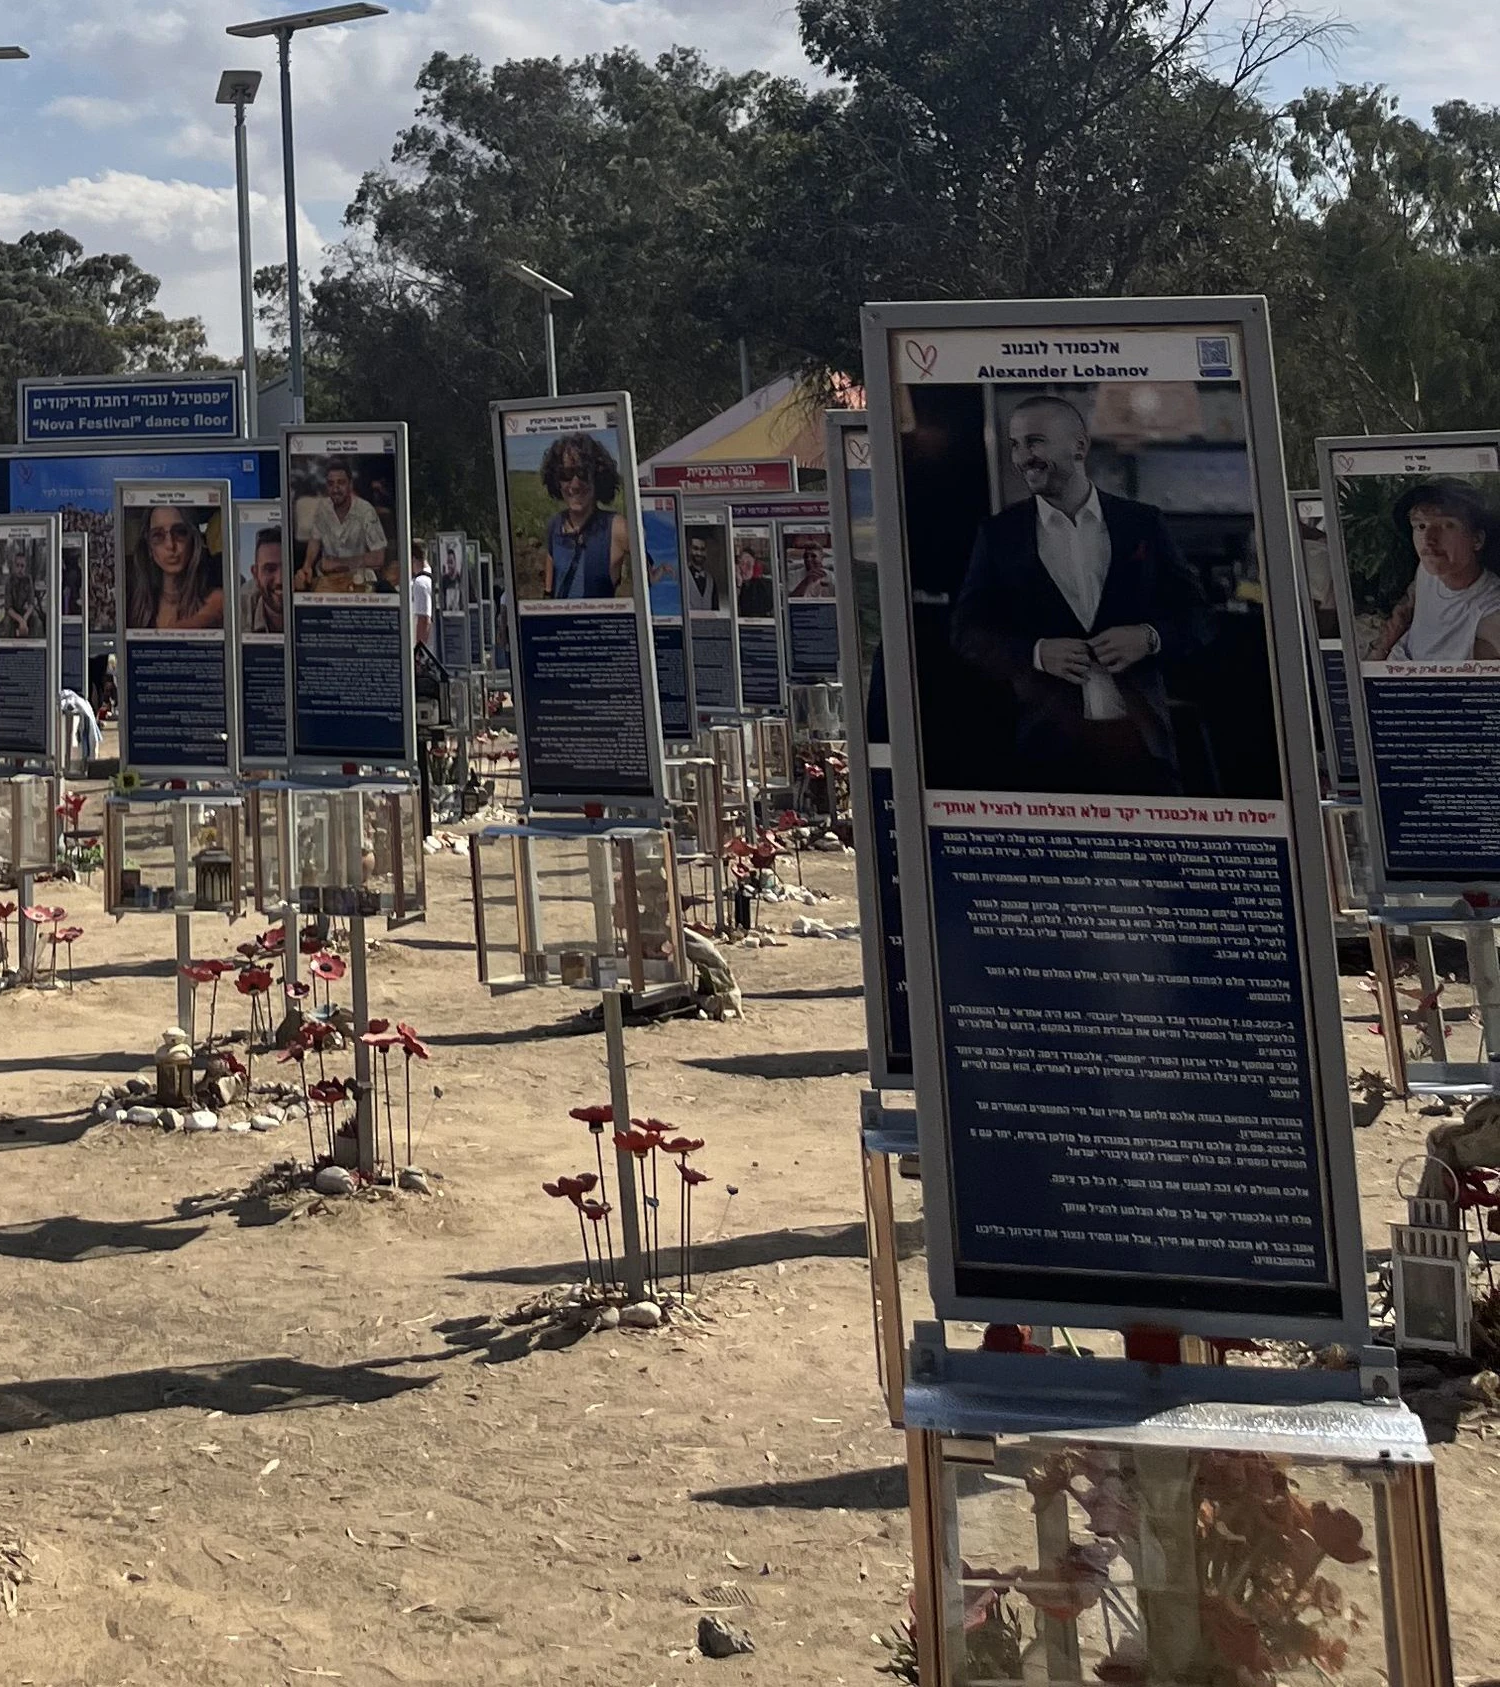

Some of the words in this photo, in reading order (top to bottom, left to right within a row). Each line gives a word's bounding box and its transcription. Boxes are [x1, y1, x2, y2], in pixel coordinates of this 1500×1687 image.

[1001, 340, 1049, 356] לובנוב
[1053, 340, 1121, 356] אלכסנדר
[977, 363, 1068, 379] Alexander
[1072, 363, 1149, 378] Lobanov
[33, 396, 92, 412] הריקודים
[94, 395, 130, 408] רחבת
[145, 414, 190, 428] dance
[193, 412, 228, 426] floor
[727, 465, 757, 477] הבמה
[679, 479, 700, 491] The
[702, 479, 731, 491] Main
[732, 477, 767, 491] Stage
[980, 799, 1024, 817] להציל
[1027, 802, 1077, 818] הצלחנו
[1079, 804, 1112, 819] שלא
[1118, 806, 1140, 822] יקר
[1147, 805, 1209, 823] אלכסנדר
[1213, 807, 1235, 822] לנו
